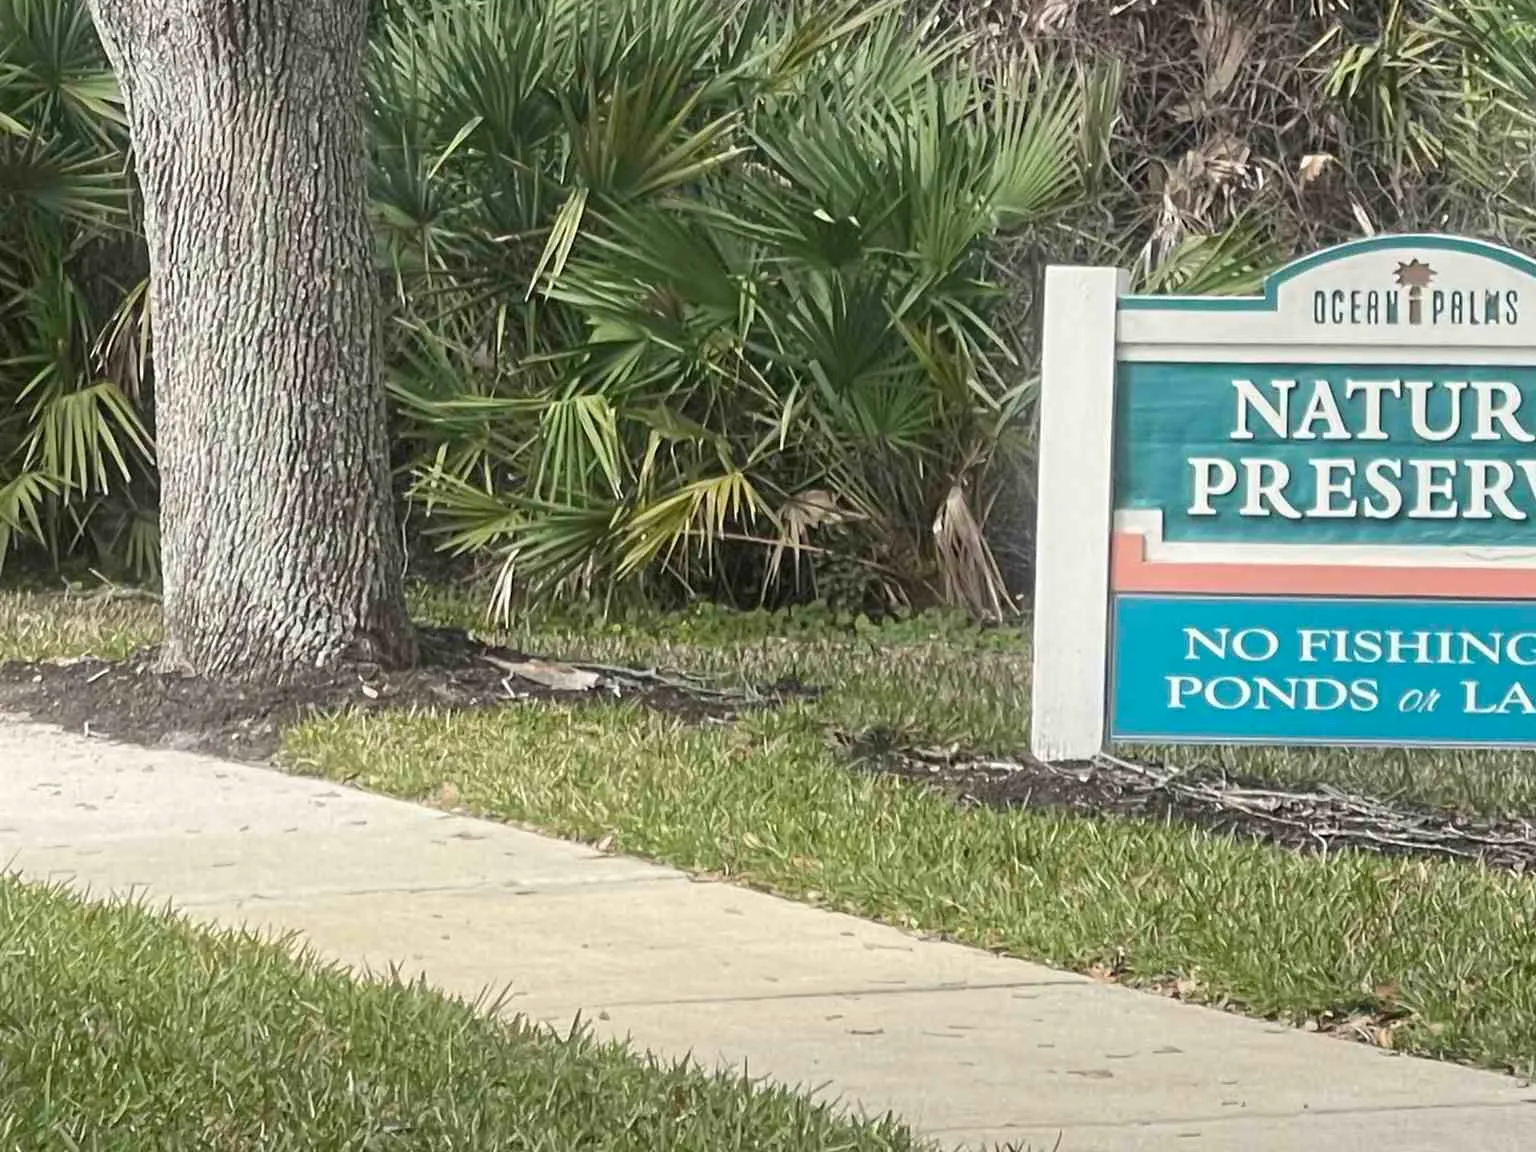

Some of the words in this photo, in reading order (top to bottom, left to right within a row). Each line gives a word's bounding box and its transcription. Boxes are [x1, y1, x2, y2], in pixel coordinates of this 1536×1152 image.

[1314, 289, 1399, 325] OCEAN
[1432, 289, 1519, 326] PALMS
[1183, 627, 1279, 663] NO
[1164, 676, 1379, 712] PONDS
